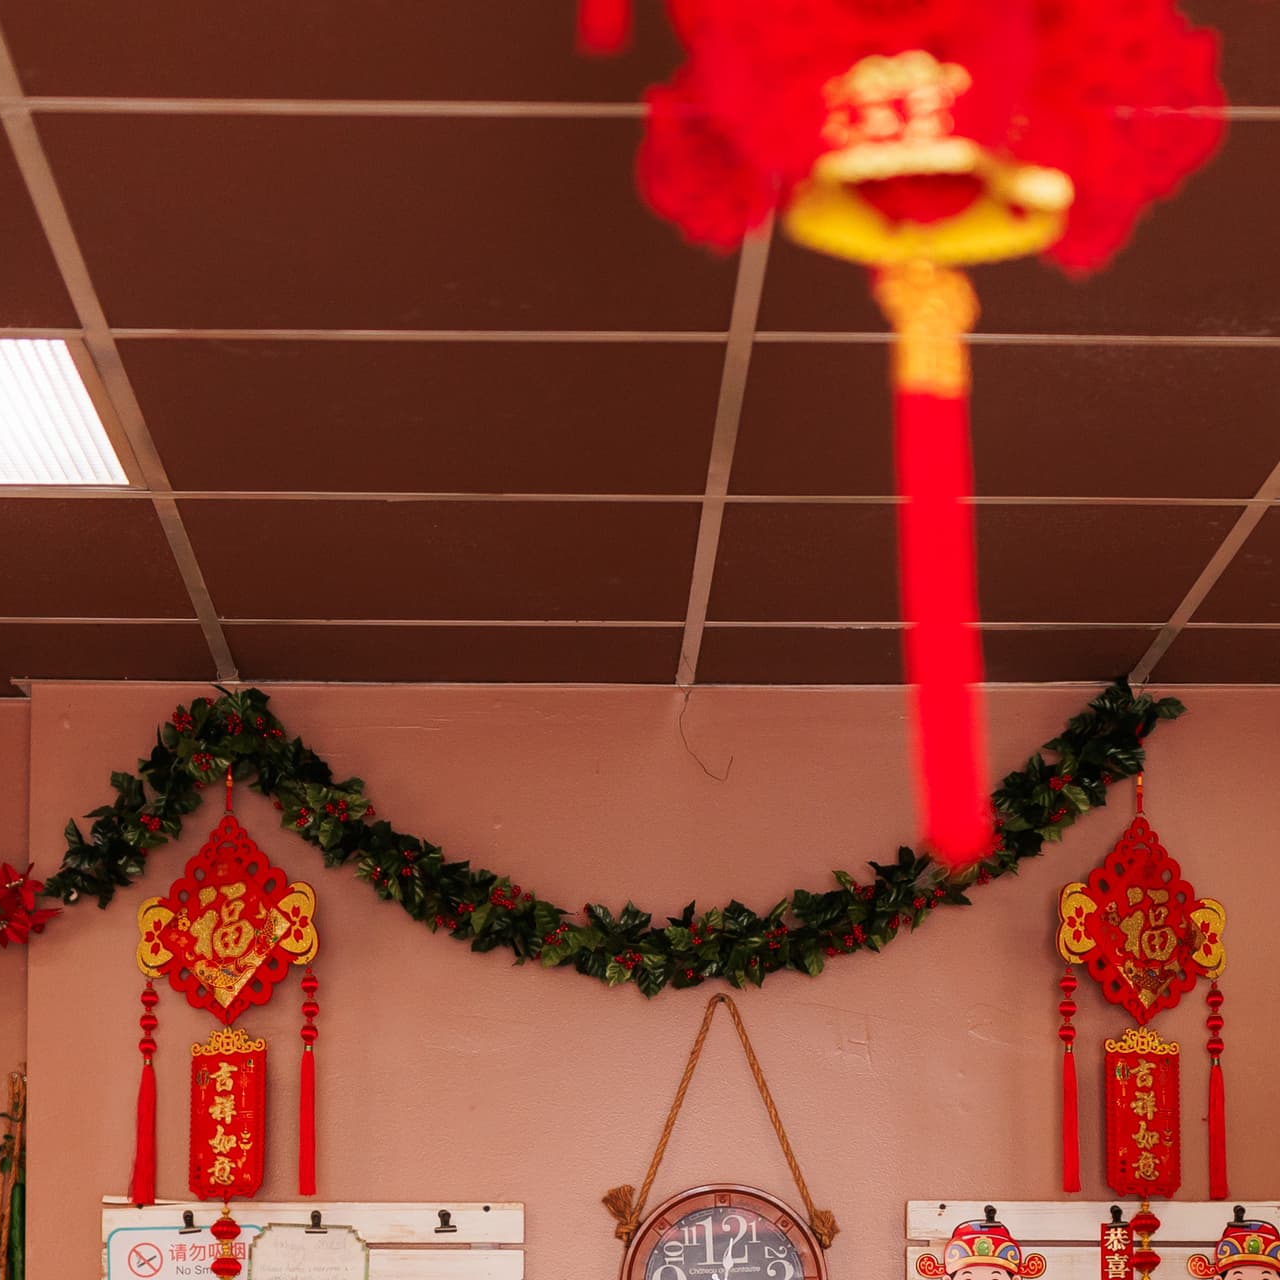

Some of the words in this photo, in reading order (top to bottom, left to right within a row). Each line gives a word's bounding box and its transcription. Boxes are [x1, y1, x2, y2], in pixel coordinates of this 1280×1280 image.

[190, 882, 256, 960] 福
[1120, 887, 1178, 961] 福
[207, 1062, 239, 1186] 吉祥如意
[1130, 1058, 1160, 1181] 吉祥如意
[175, 1266, 191, 1275] No
[696, 1214, 749, 1266] 12
